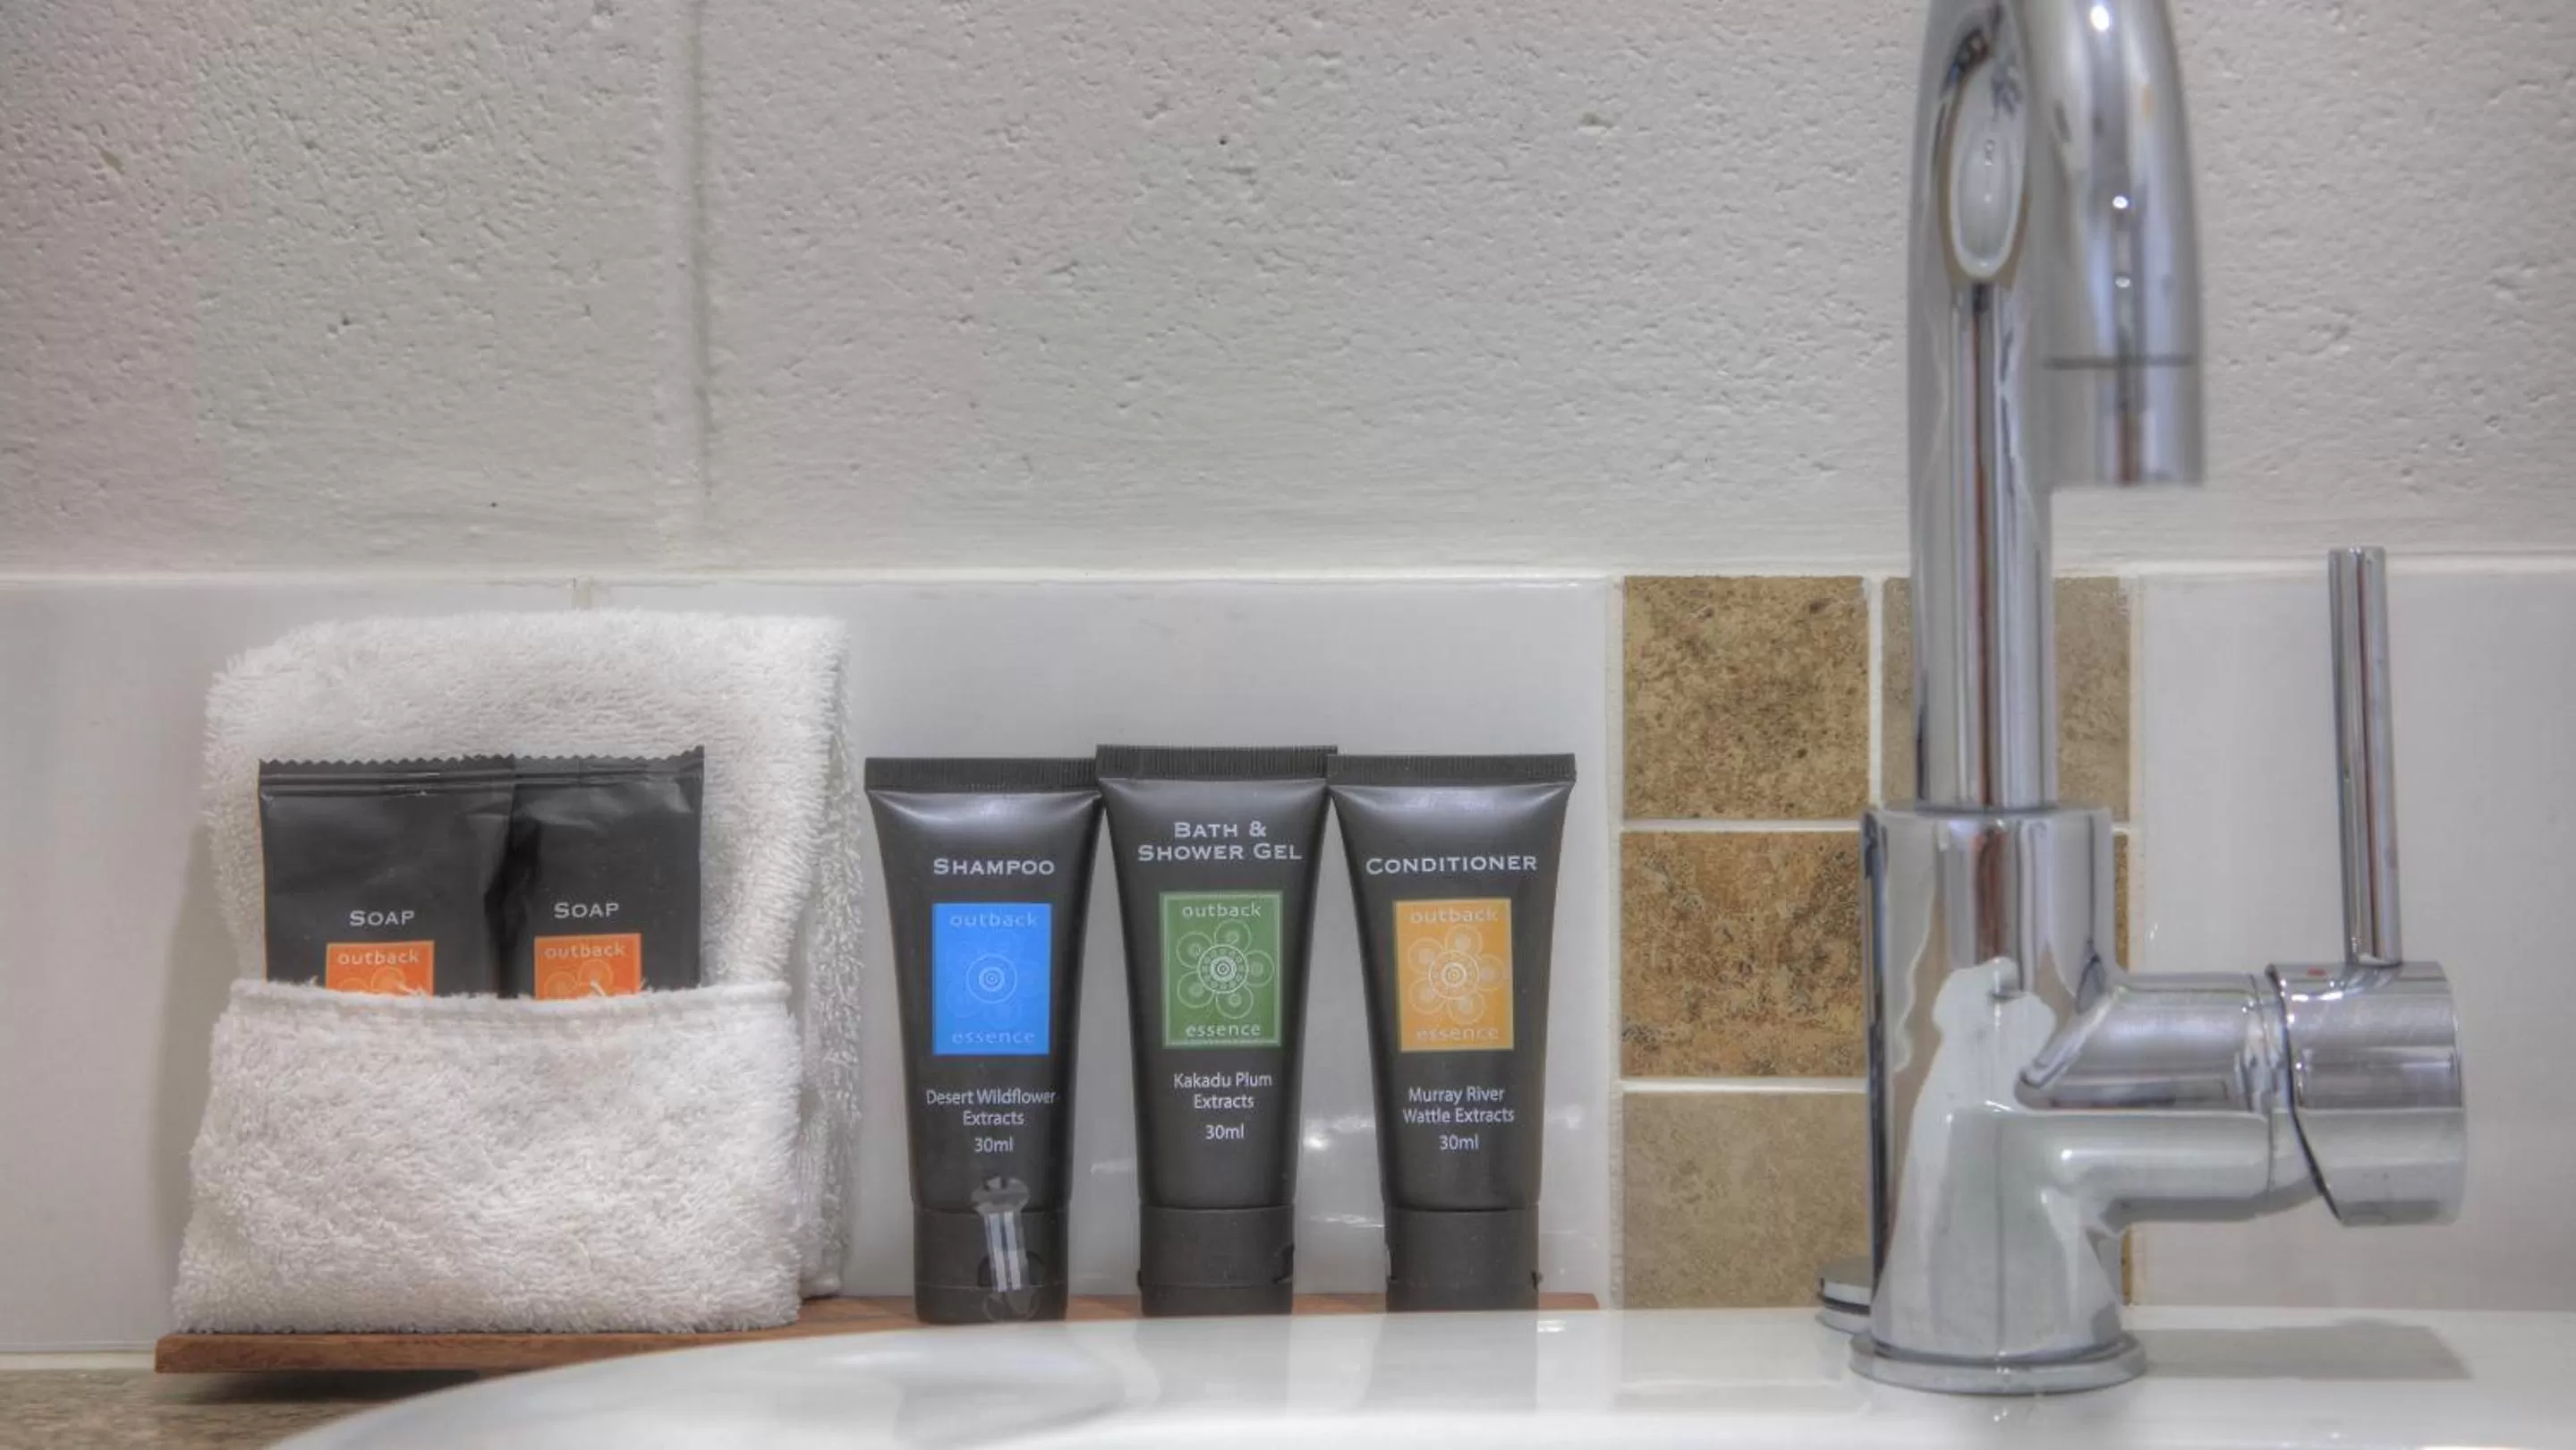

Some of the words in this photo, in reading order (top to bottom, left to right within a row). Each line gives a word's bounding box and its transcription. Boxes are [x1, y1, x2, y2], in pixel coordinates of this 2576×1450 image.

[1174, 822, 1238, 838] BATH
[1248, 821, 1267, 838] &
[1137, 844, 1245, 862] SHOWER
[1253, 843, 1303, 861] GEL
[933, 857, 1056, 876] SHAMPOO
[1365, 856, 1538, 875] CONDITIONER
[349, 908, 415, 927] SOAP
[554, 901, 620, 919] SOAP
[1181, 902, 1262, 919] outback
[1408, 907, 1499, 924] outback
[949, 910, 1039, 929] outback
[337, 949, 421, 966] outback
[544, 941, 625, 959] outback
[951, 1029, 1035, 1045] essence
[1185, 1023, 1262, 1037] essence
[1416, 1027, 1499, 1041] essence
[1173, 1072, 1231, 1088] Kakadu
[1236, 1071, 1272, 1088] Plum
[926, 1088, 973, 1105] Desert
[976, 1088, 1057, 1105] Wildflower
[1194, 1093, 1254, 1109] Extracts
[1408, 1086, 1463, 1106] Murray
[1467, 1086, 1505, 1102] River
[963, 1110, 1024, 1126] Extracts
[1402, 1107, 1451, 1123] Wattle
[1455, 1106, 1515, 1122] Extracts
[1205, 1123, 1245, 1139] 30ml
[973, 1137, 1014, 1153] 30ml
[1439, 1134, 1479, 1151] 30ml
